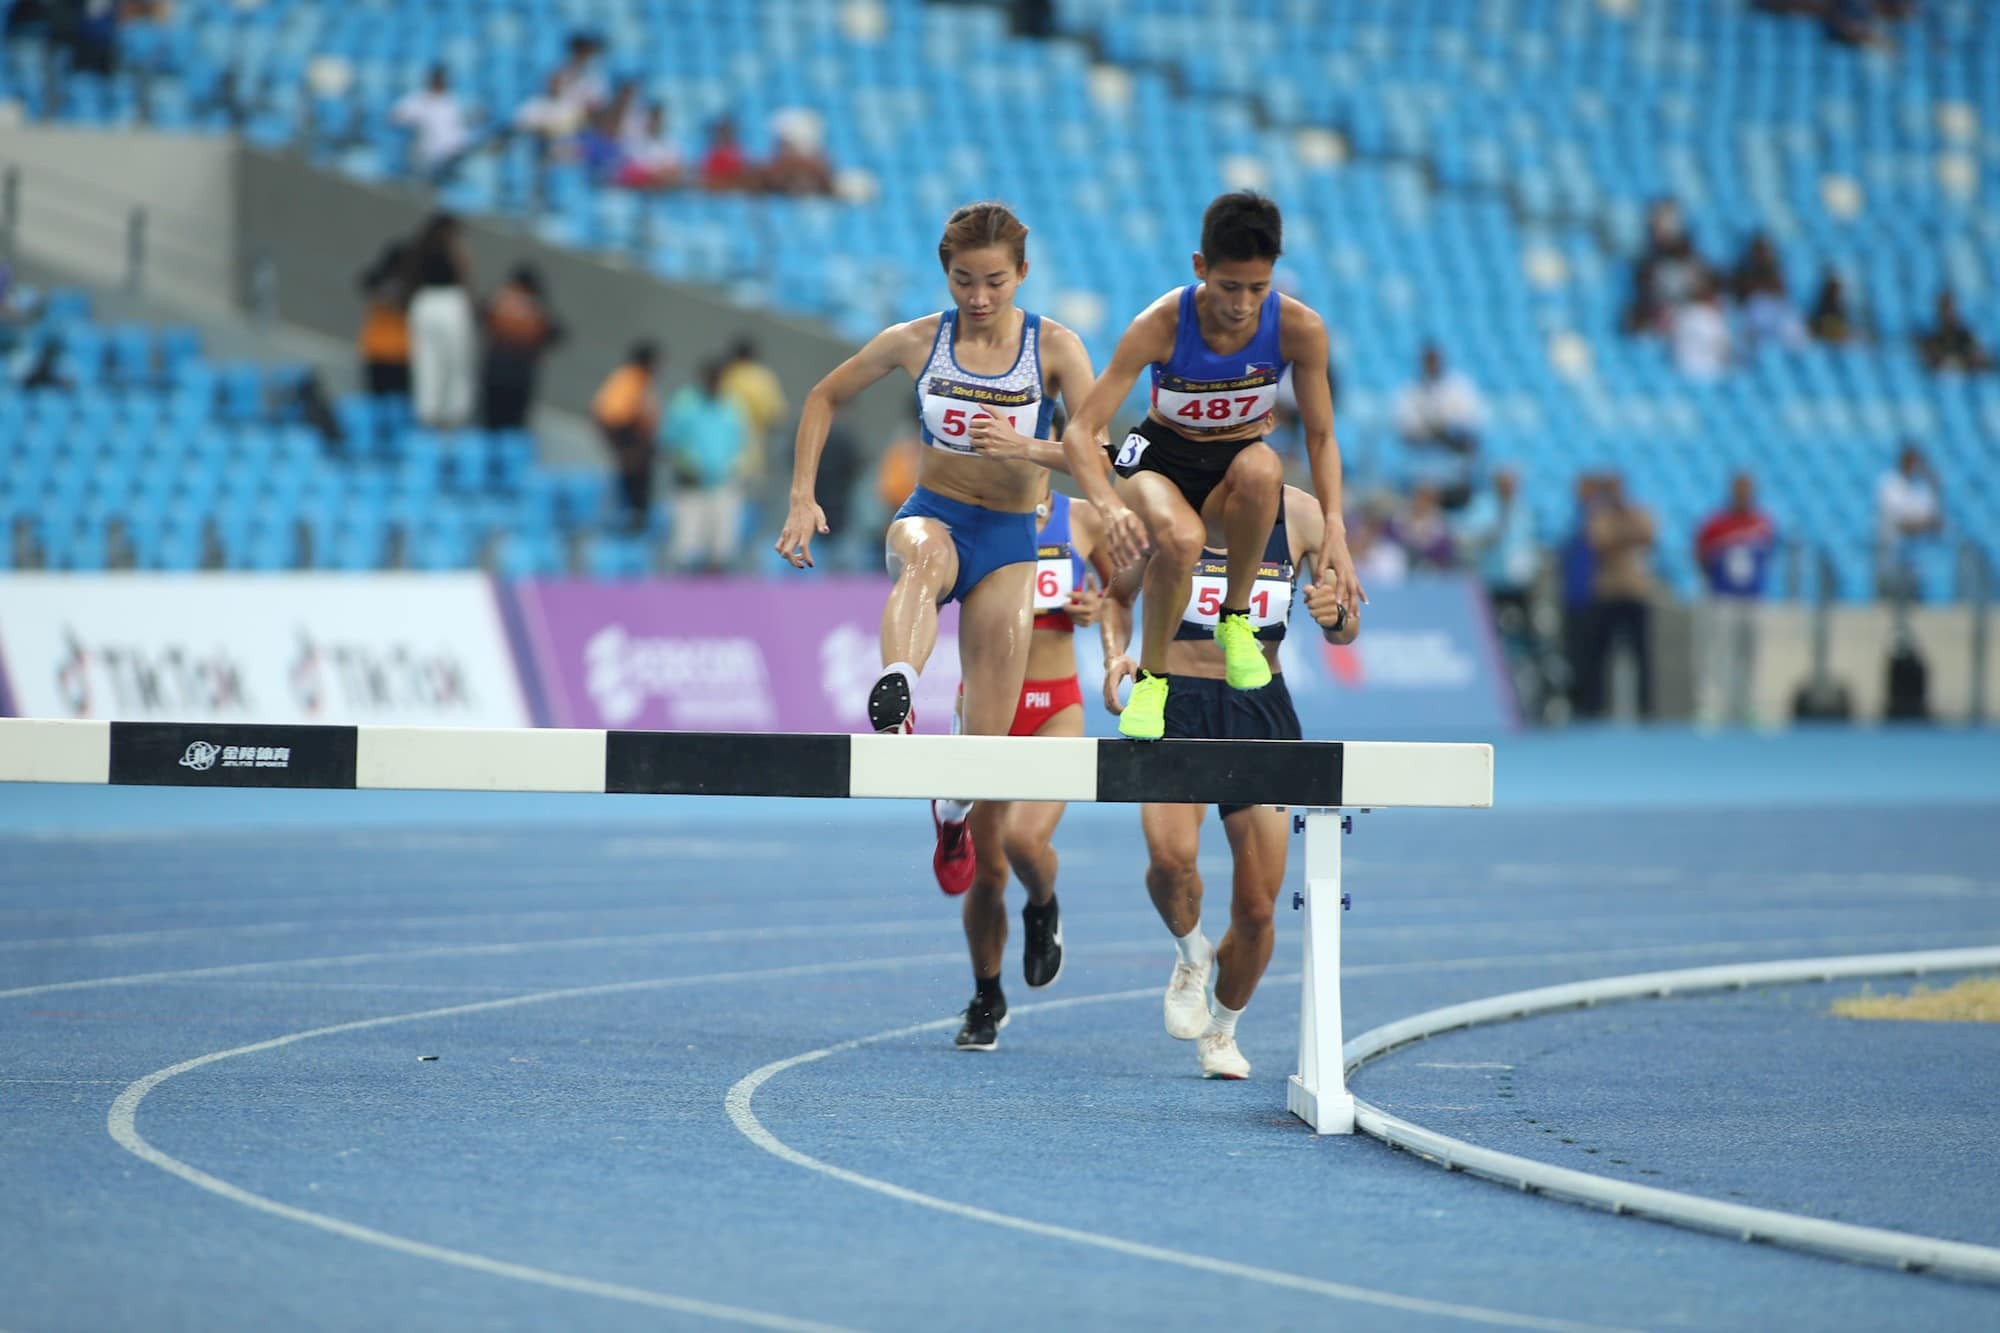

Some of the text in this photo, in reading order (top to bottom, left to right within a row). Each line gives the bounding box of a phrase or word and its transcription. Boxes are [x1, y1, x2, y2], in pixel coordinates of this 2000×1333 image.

[1208, 381, 1228, 390] SEA
[1230, 376, 1265, 388] GAMES
[951, 385, 1028, 403] 32nd SEA GAMES
[1177, 395, 1259, 420] 487
[1118, 436, 1138, 465] 3
[1205, 565, 1280, 577] 32nd MES
[1197, 587, 1269, 618] 51
[1025, 691, 1050, 708] PHI
